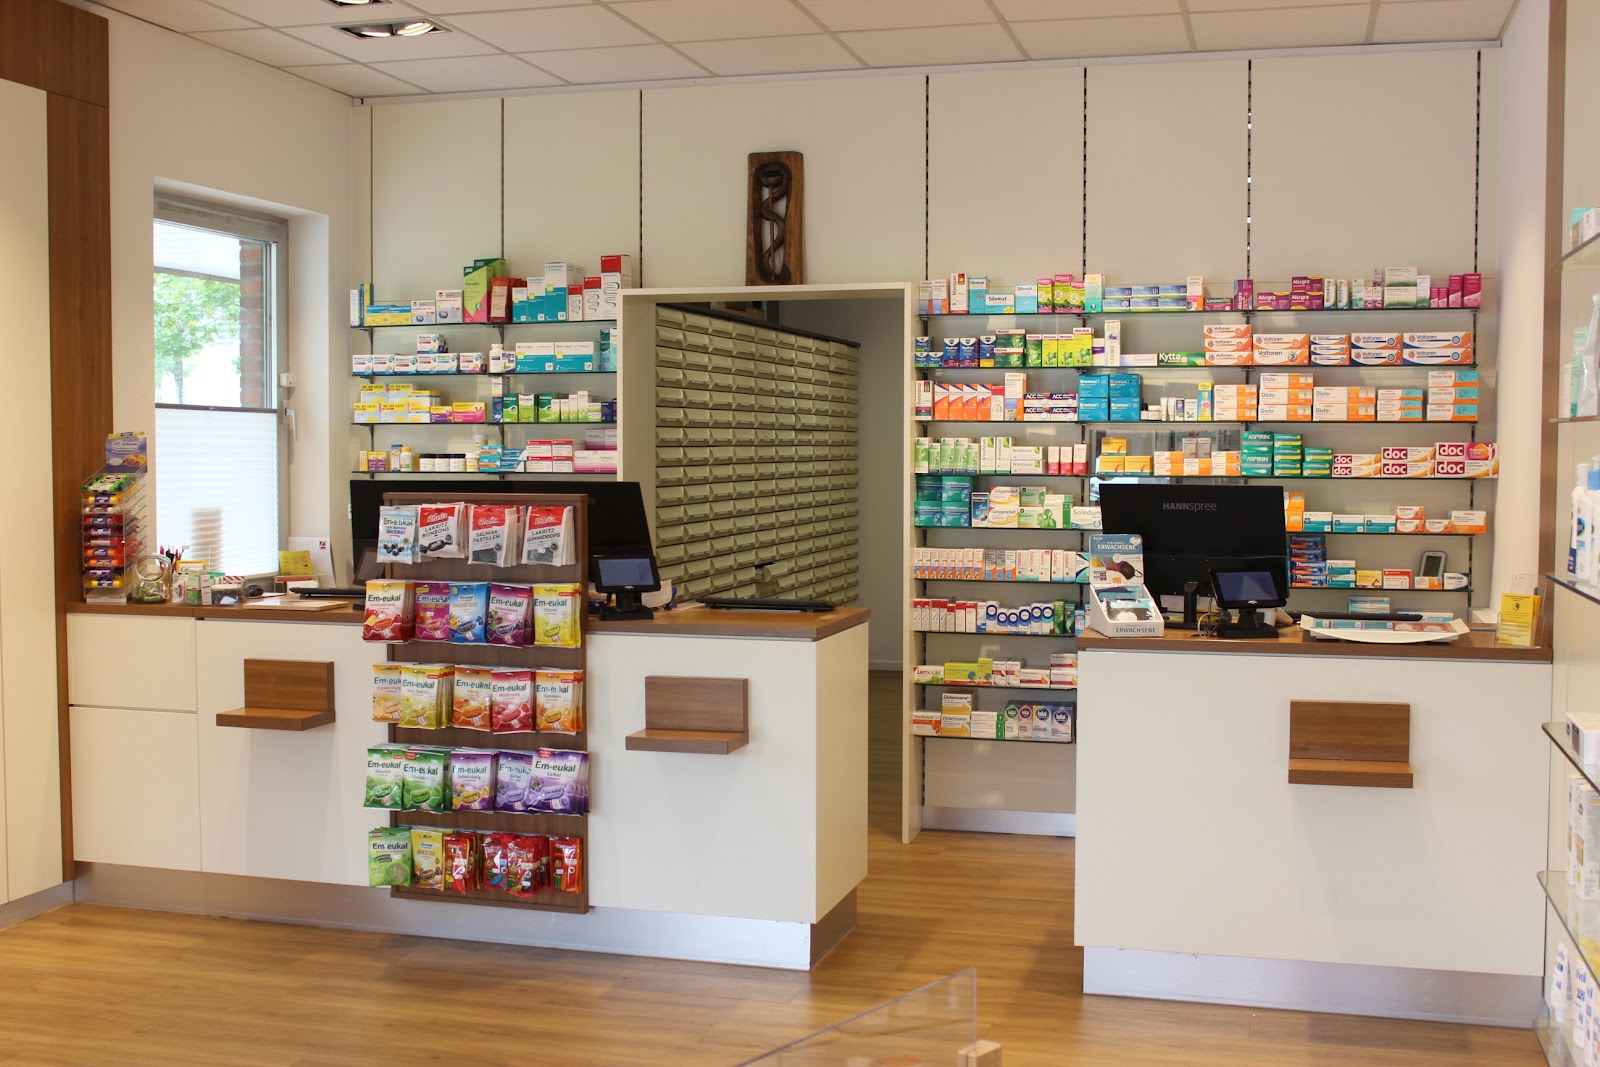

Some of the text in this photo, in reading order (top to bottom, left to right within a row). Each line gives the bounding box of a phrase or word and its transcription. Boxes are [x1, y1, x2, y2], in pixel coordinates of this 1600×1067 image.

[1159, 353, 1181, 362] Kytta
[1384, 448, 1407, 459] doc
[1440, 444, 1463, 455] doc
[1335, 456, 1351, 464] doc
[1334, 467, 1351, 475] doc
[1384, 463, 1407, 474] doc
[1438, 461, 1464, 474] doc
[1163, 502, 1217, 512] HANNspree
[425, 522, 448, 532] LAKRITZ
[422, 527, 449, 538] BONBONS
[531, 528, 554, 536] LAKRITZ
[473, 534, 500, 542] PASTILLEN
[527, 533, 560, 542] GUMMIDROPS
[368, 594, 401, 602] Em-eukal
[417, 595, 449, 603] Em-eukal
[491, 597, 523, 607] Em-eukal
[402, 680, 434, 688] Em-eukal
[456, 680, 491, 689] Em-eukal
[493, 684, 527, 692] Em-eukal
[404, 764, 438, 775] Em-eukal
[499, 764, 531, 775] Em-euka
[535, 761, 576, 773] Em-eukal
